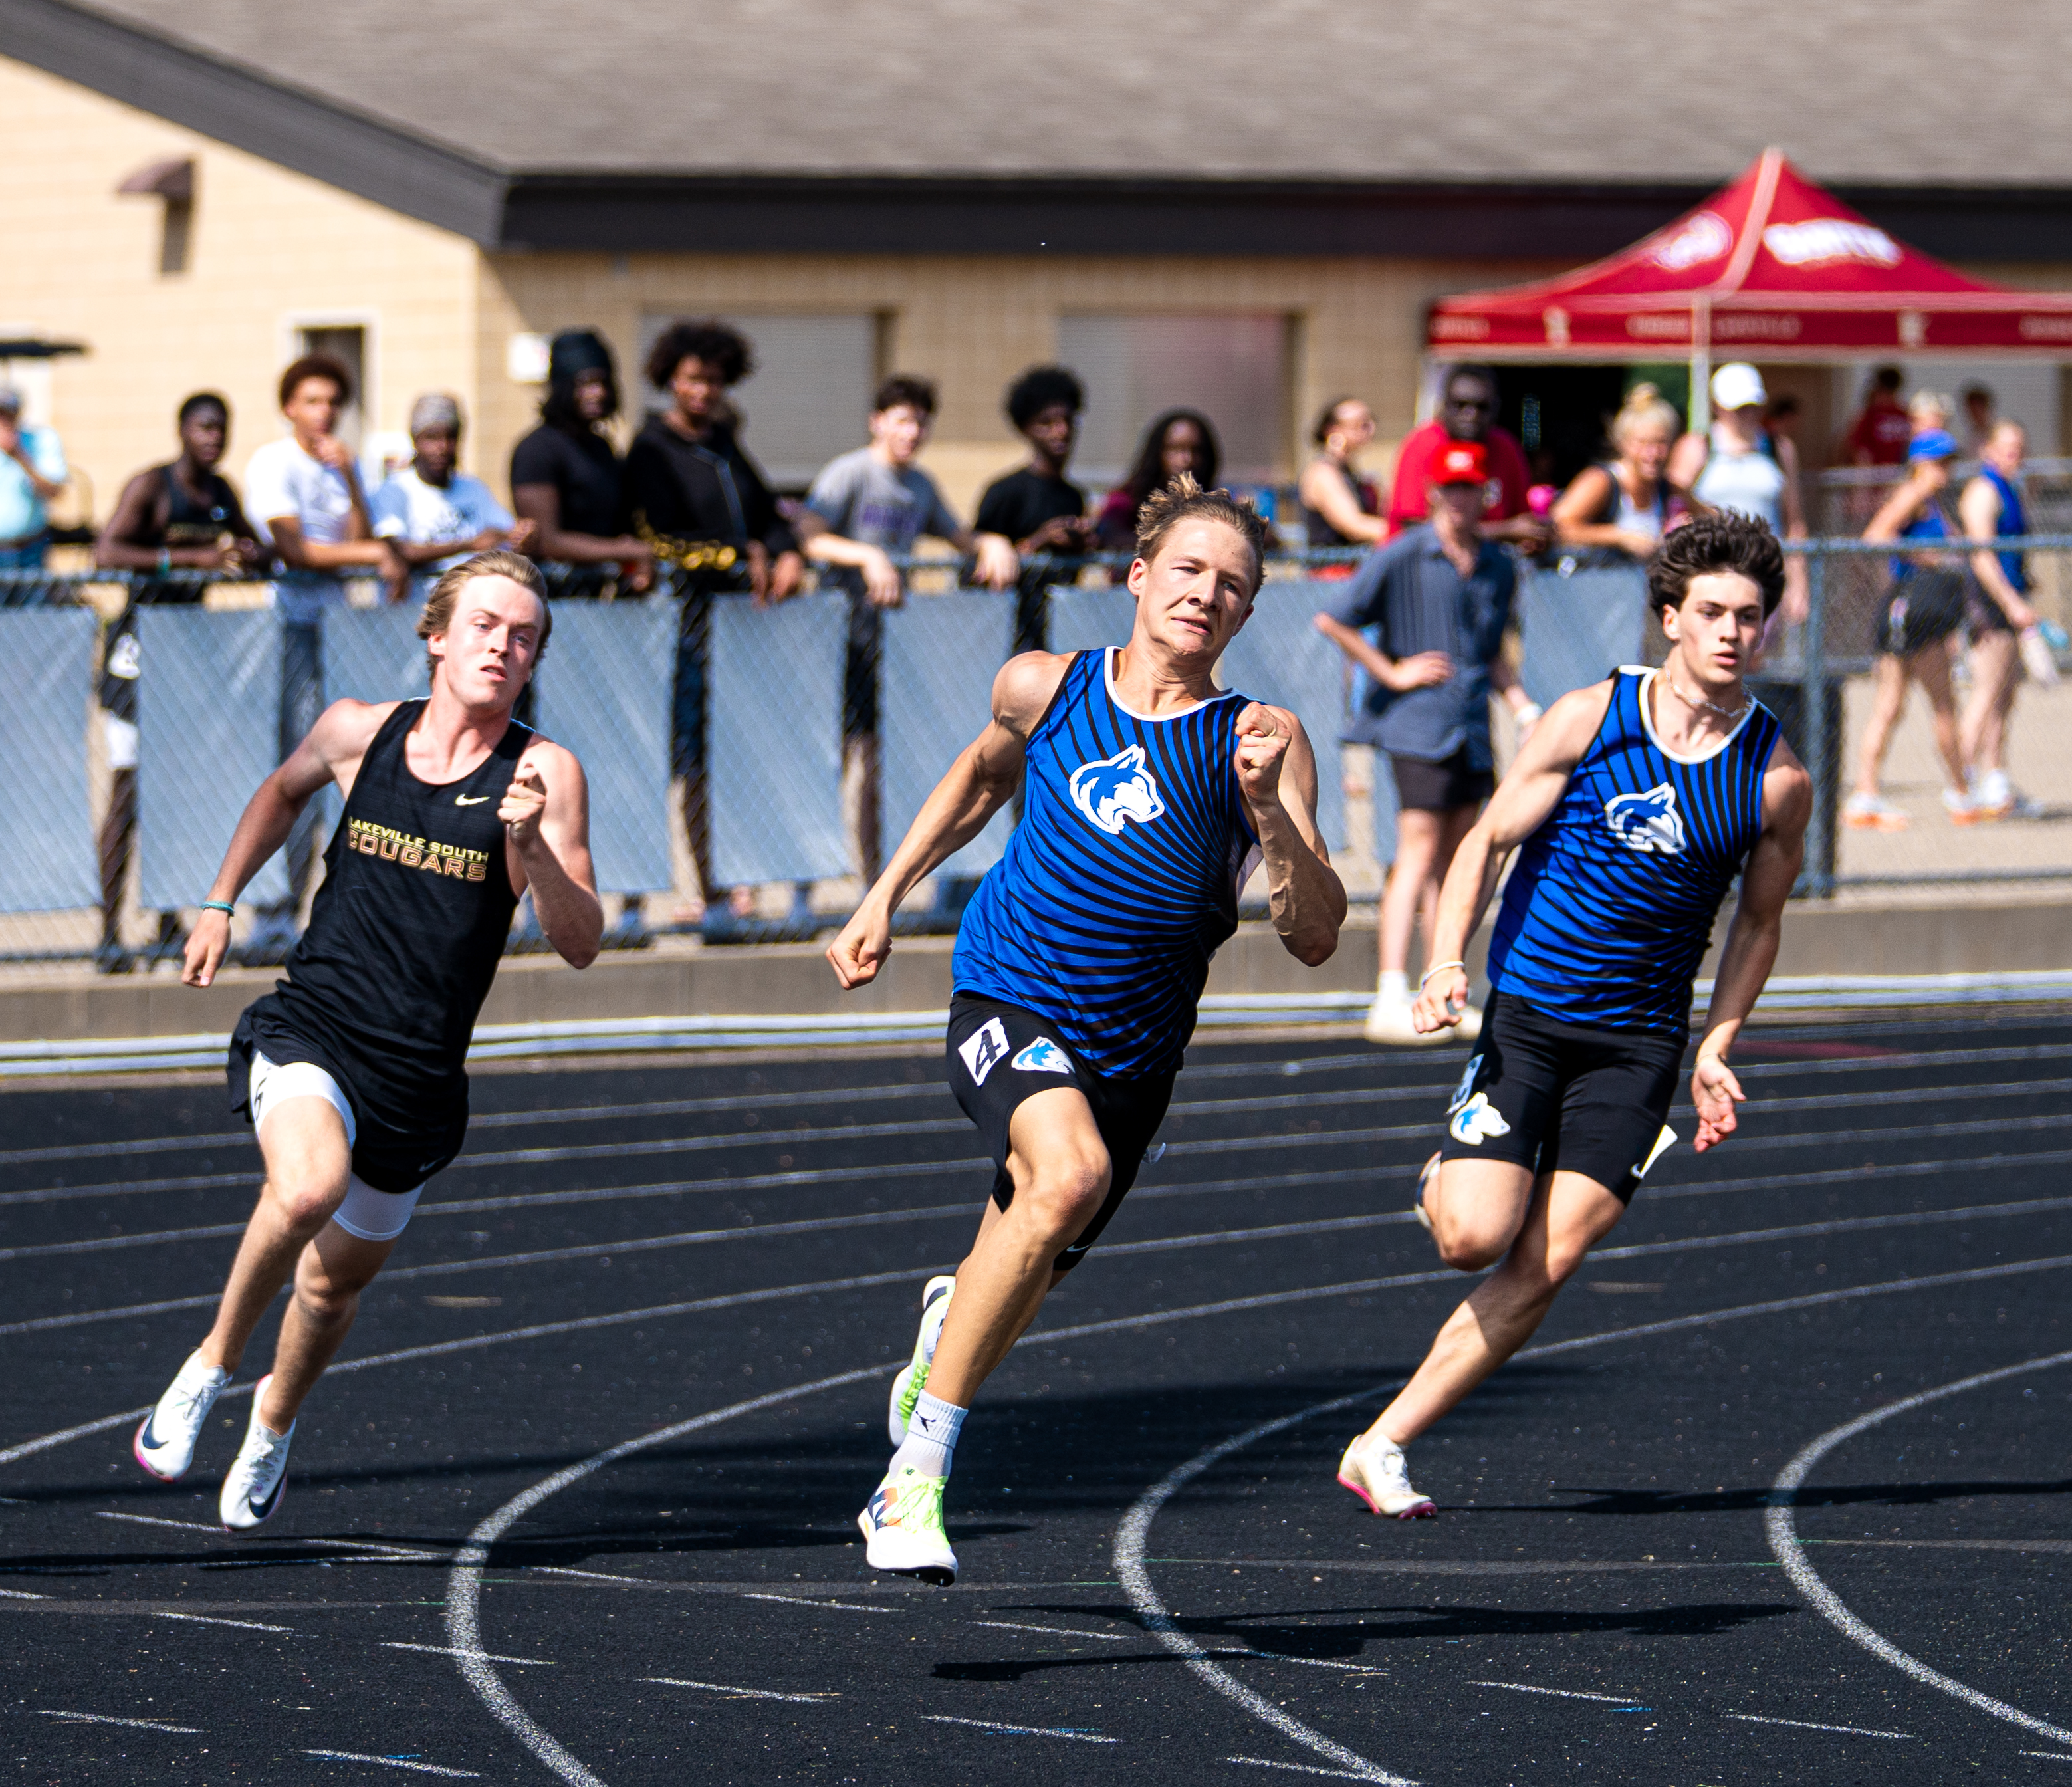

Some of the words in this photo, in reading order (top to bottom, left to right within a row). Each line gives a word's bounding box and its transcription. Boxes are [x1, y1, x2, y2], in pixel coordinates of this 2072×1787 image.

[348, 816, 426, 848] LAKEVILLE
[429, 841, 488, 863] SOUTH
[348, 830, 487, 882] COUGARS
[975, 1028, 1002, 1078] 4
